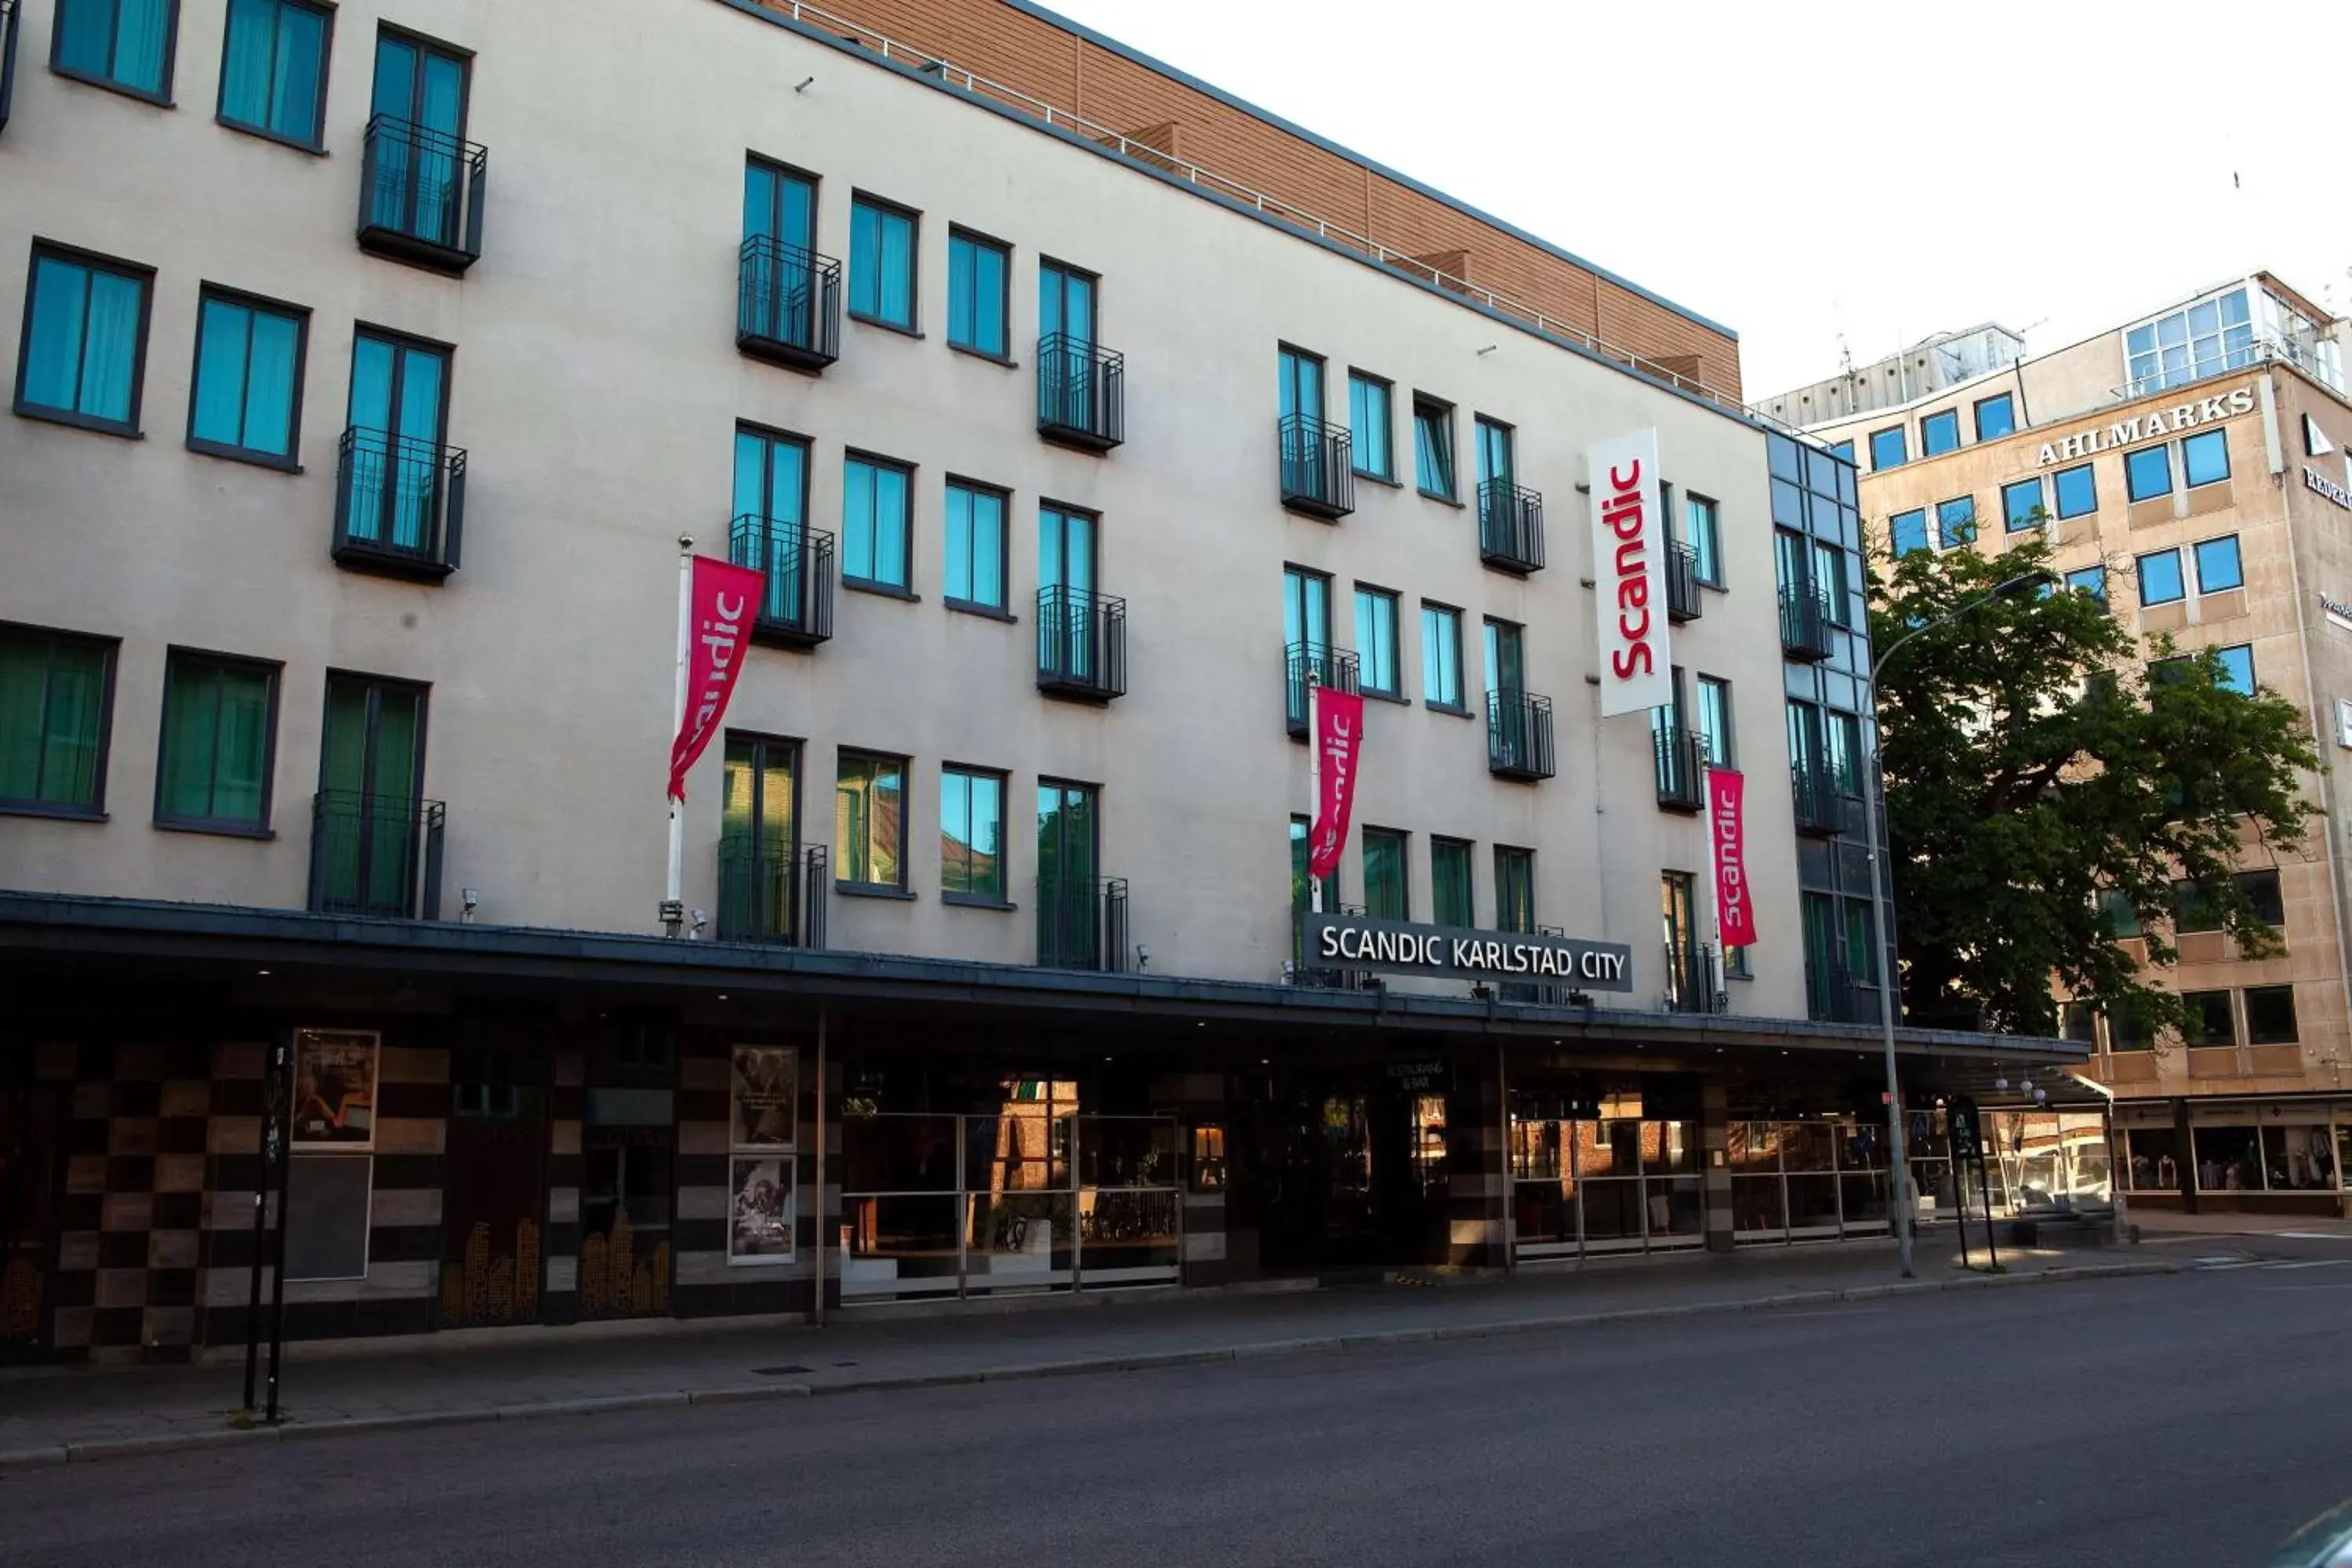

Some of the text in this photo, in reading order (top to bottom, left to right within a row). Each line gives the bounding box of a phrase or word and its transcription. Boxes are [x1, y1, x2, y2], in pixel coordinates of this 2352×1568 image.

[2036, 387, 2255, 468] AHLMARKS
[1602, 459, 1654, 681] Scandic
[1718, 789, 1742, 927] scandic
[1322, 926, 1625, 980] SCANDIC KARLSTAD CITY
